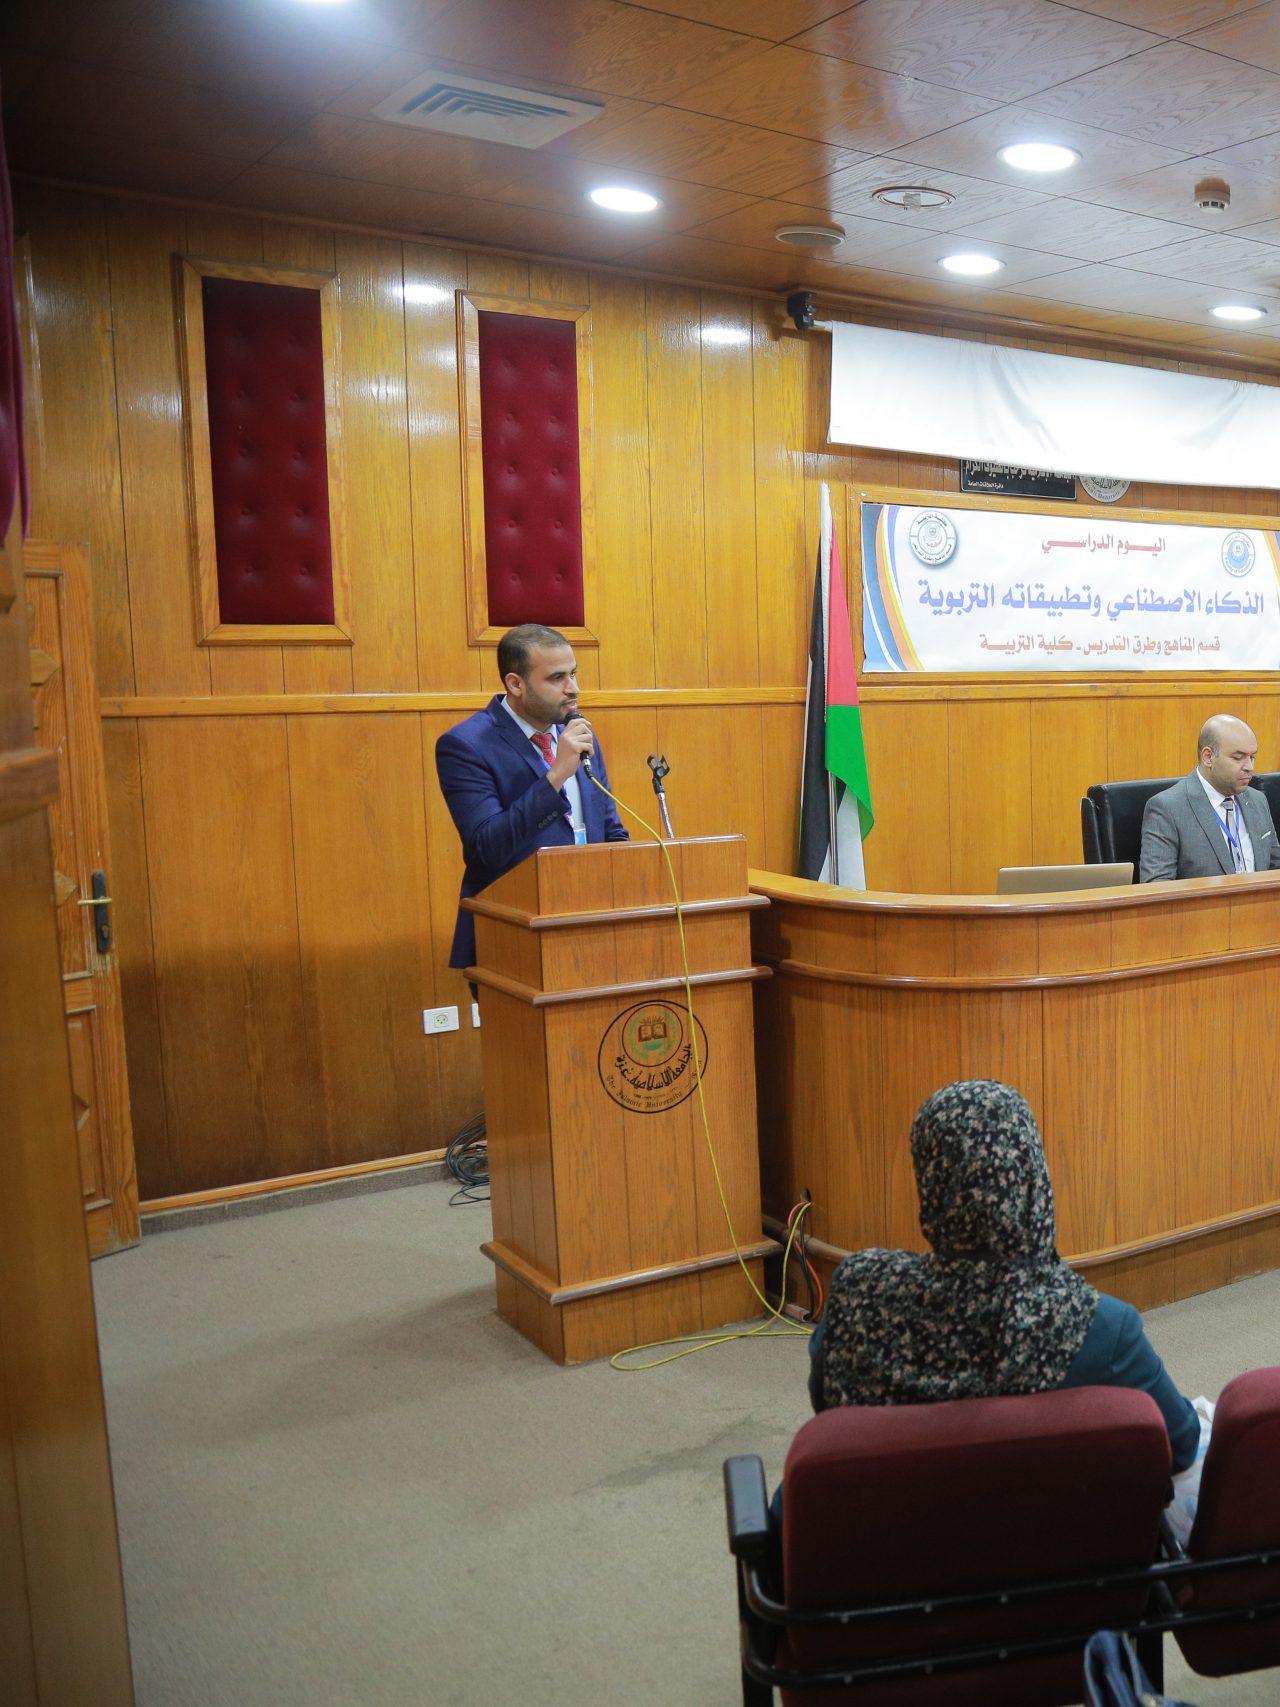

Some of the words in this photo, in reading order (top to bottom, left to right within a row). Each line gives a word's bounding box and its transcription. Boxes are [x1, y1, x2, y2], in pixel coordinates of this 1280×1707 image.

[1041, 532, 1114, 554] الدراسي
[917, 579, 995, 616] التربوية
[1001, 583, 1102, 617] وتطبيقاته
[1107, 587, 1201, 622] الاصطناعي
[1205, 590, 1264, 615] الذكاء
[979, 633, 1035, 655] التربية
[1037, 633, 1073, 655] كلية
[1083, 635, 1130, 656] التدريس
[1132, 635, 1161, 655] وطرق
[1163, 636, 1196, 656] المناهج
[1198, 635, 1220, 655] قسم
[646, 1090, 683, 1109] University
